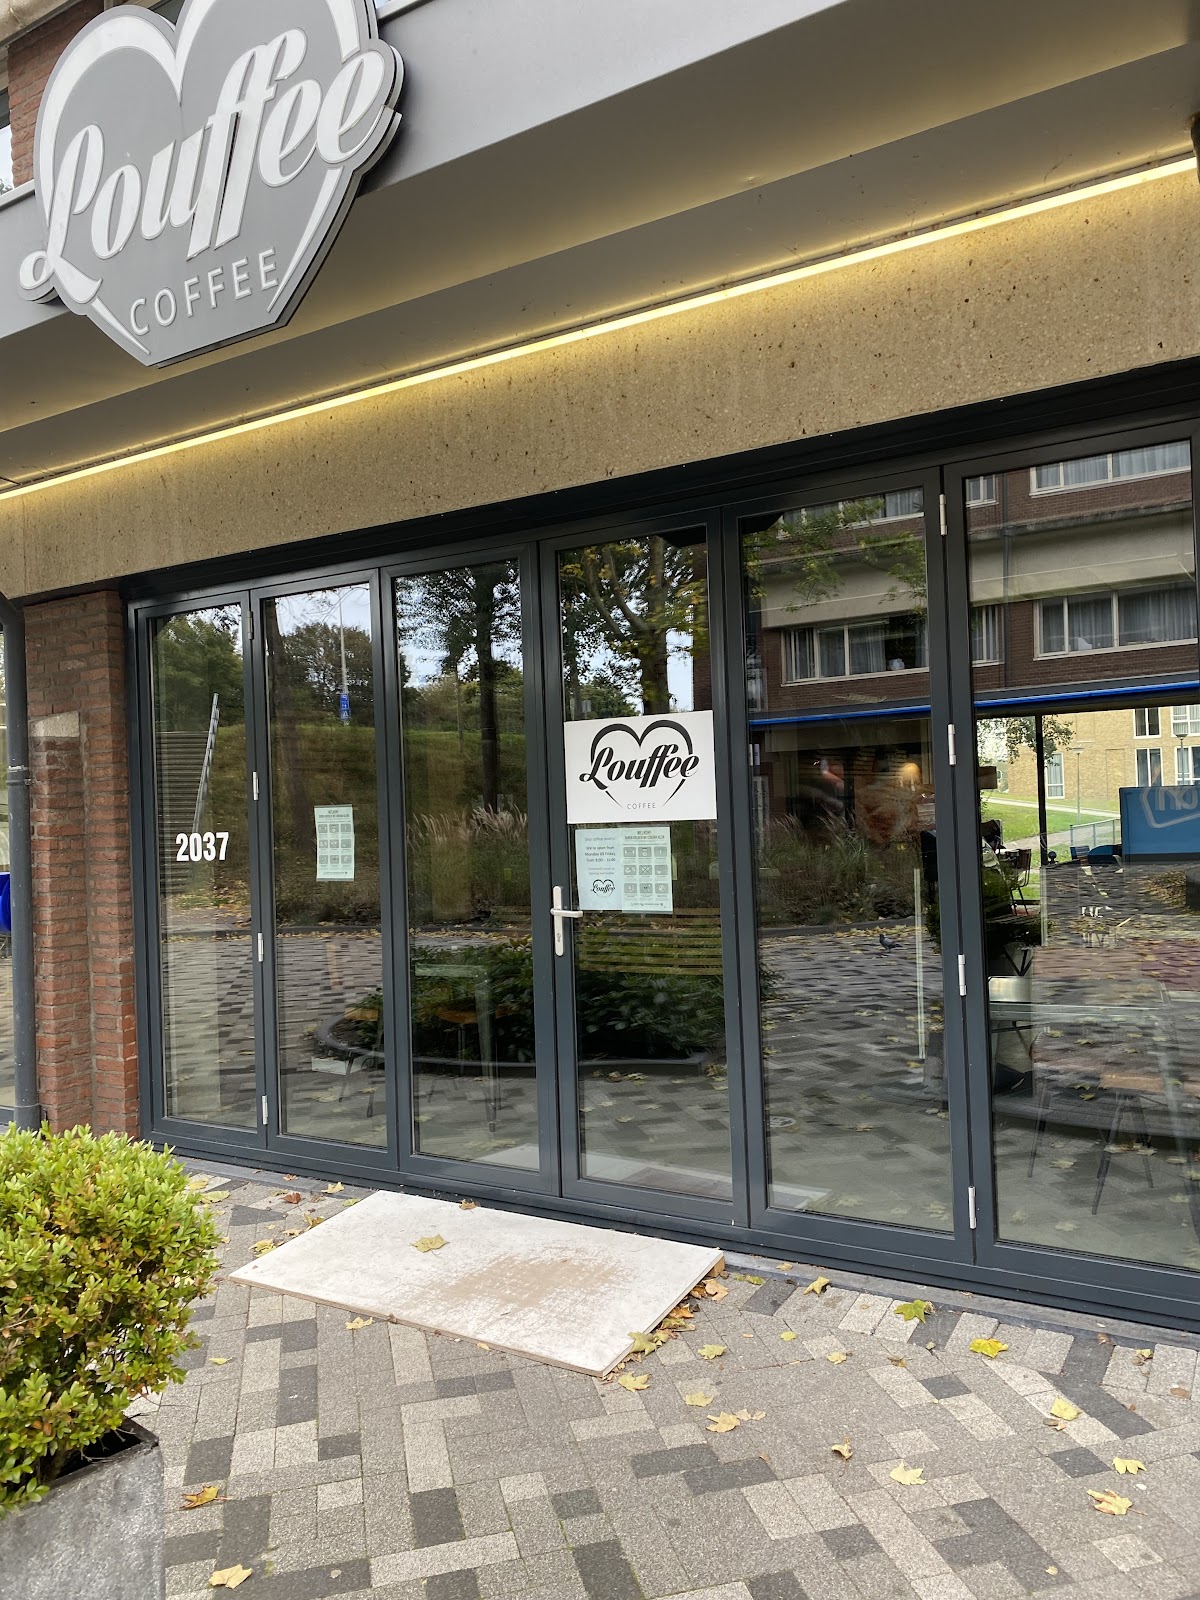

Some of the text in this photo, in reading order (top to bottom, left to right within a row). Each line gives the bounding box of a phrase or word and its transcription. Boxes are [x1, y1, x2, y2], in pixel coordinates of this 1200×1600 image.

[19, 29, 385, 303] Louffee
[130, 247, 279, 336] COFFEE
[579, 744, 700, 790] Louffee
[626, 802, 656, 810] COFFEE
[175, 831, 229, 862] 2037
